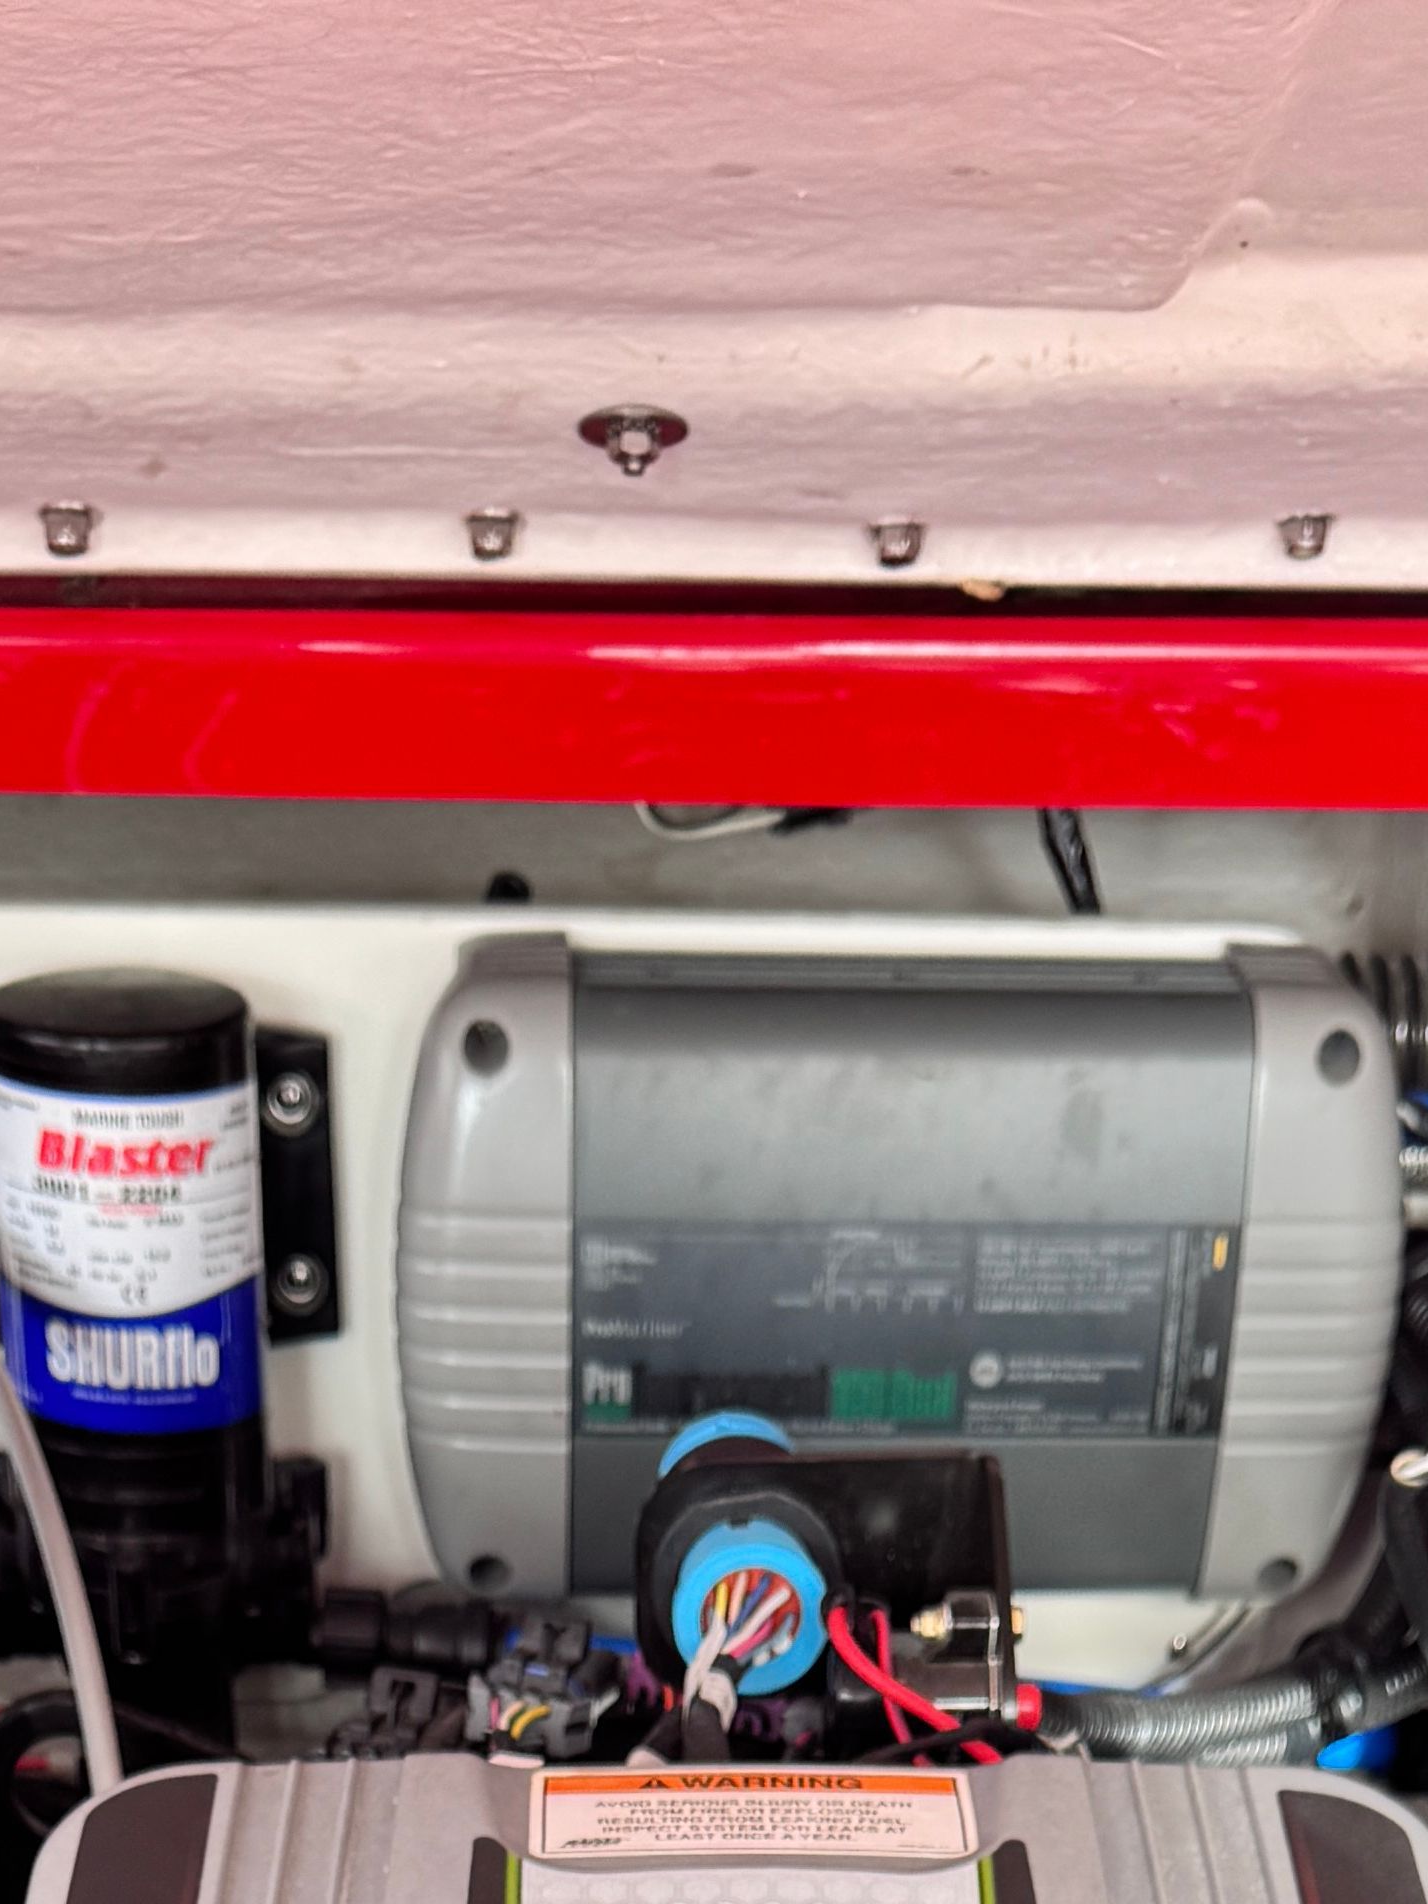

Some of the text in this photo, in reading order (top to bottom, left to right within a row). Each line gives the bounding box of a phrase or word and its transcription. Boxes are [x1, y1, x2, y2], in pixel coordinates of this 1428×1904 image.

[38, 1129, 215, 1177] Blaster
[681, 1777, 862, 1790] WARNING
[596, 1800, 651, 1808] AVOID
[598, 1817, 703, 1825] RESULTING
[710, 1817, 762, 1825] FROM
[603, 1826, 906, 1834] INSPECT SYSTEM FOR LEAKS AT
[655, 1834, 715, 1842] LEAST
[722, 1834, 775, 1842] ONCE
